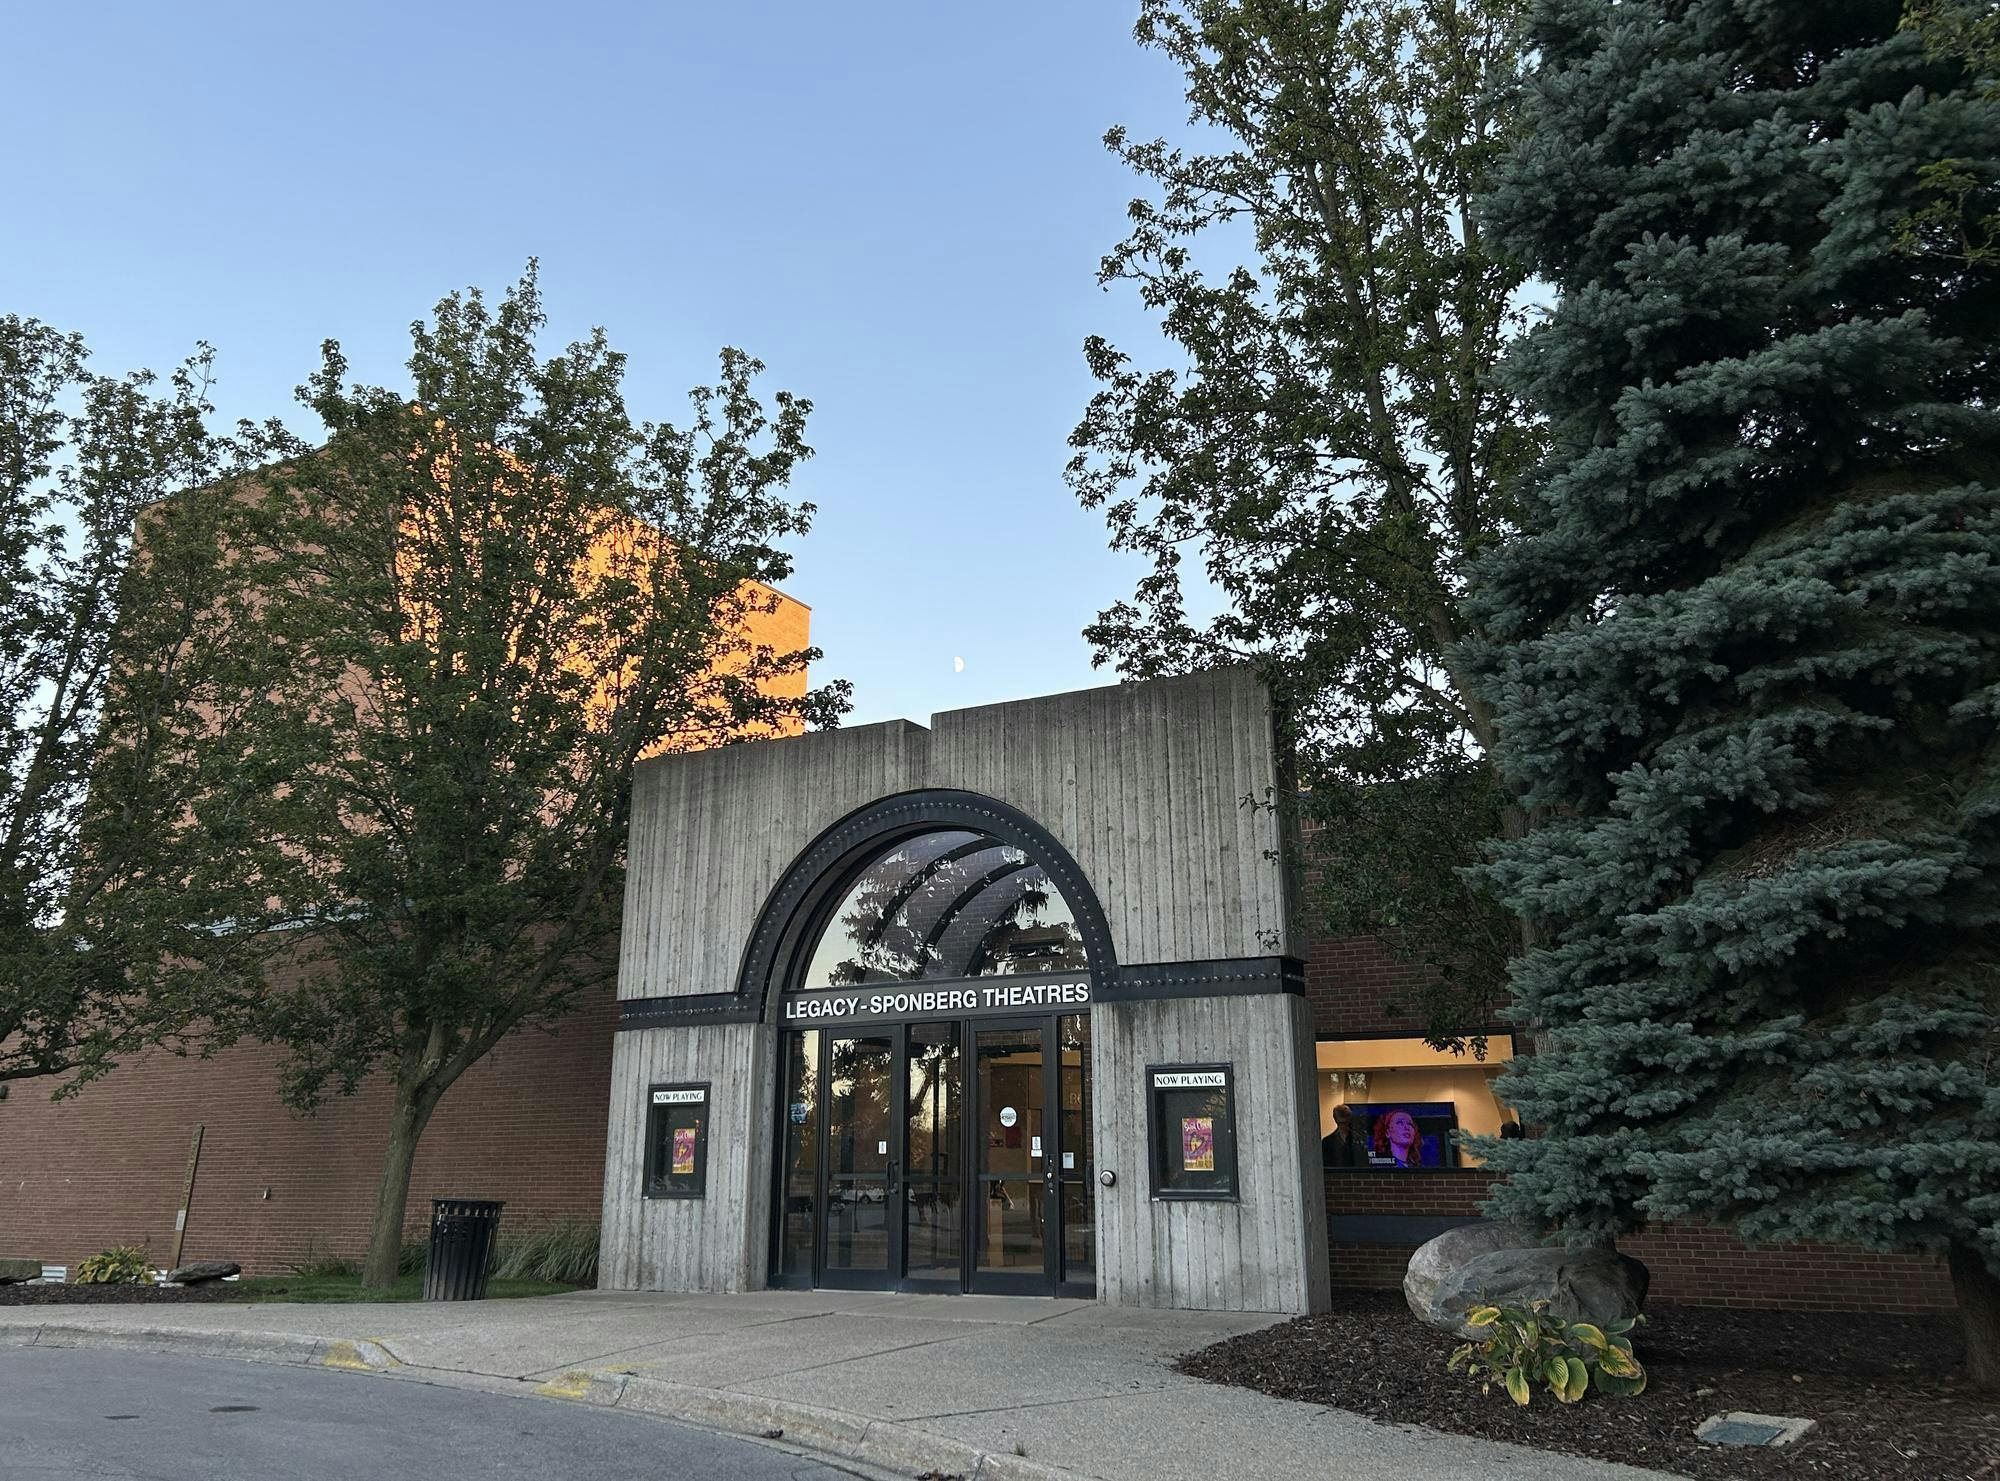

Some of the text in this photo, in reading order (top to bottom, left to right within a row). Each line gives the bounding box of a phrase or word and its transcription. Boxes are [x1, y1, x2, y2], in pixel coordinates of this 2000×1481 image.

[983, 983, 1089, 1007] THEATRES
[1156, 1075, 1222, 1086] NOW PLAYING
[655, 1091, 702, 1102] NOW PLAYING
